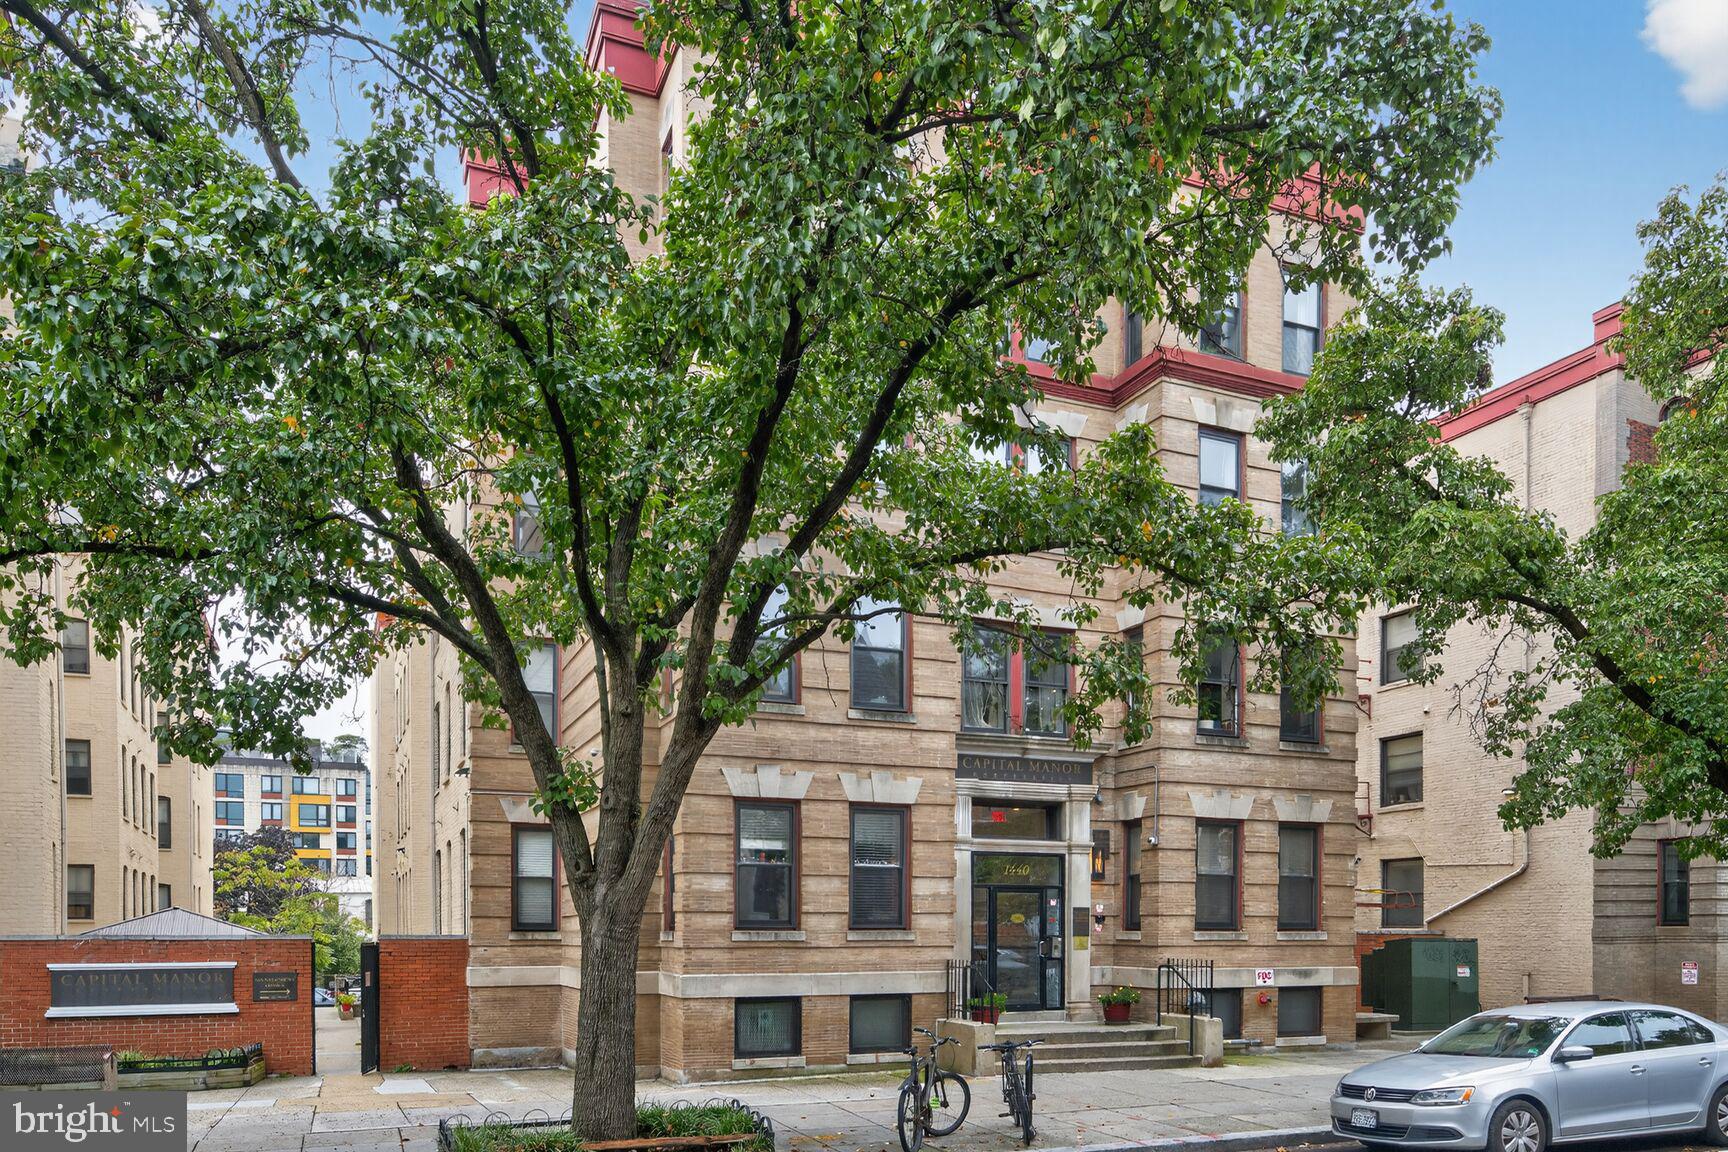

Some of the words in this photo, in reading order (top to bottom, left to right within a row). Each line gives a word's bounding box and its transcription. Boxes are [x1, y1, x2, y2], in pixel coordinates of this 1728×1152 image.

[962, 757, 1024, 771] CAPITAL
[1029, 761, 1081, 774] MANOR
[60, 973, 144, 987] CAPITAL
[152, 971, 225, 985] MANOR
